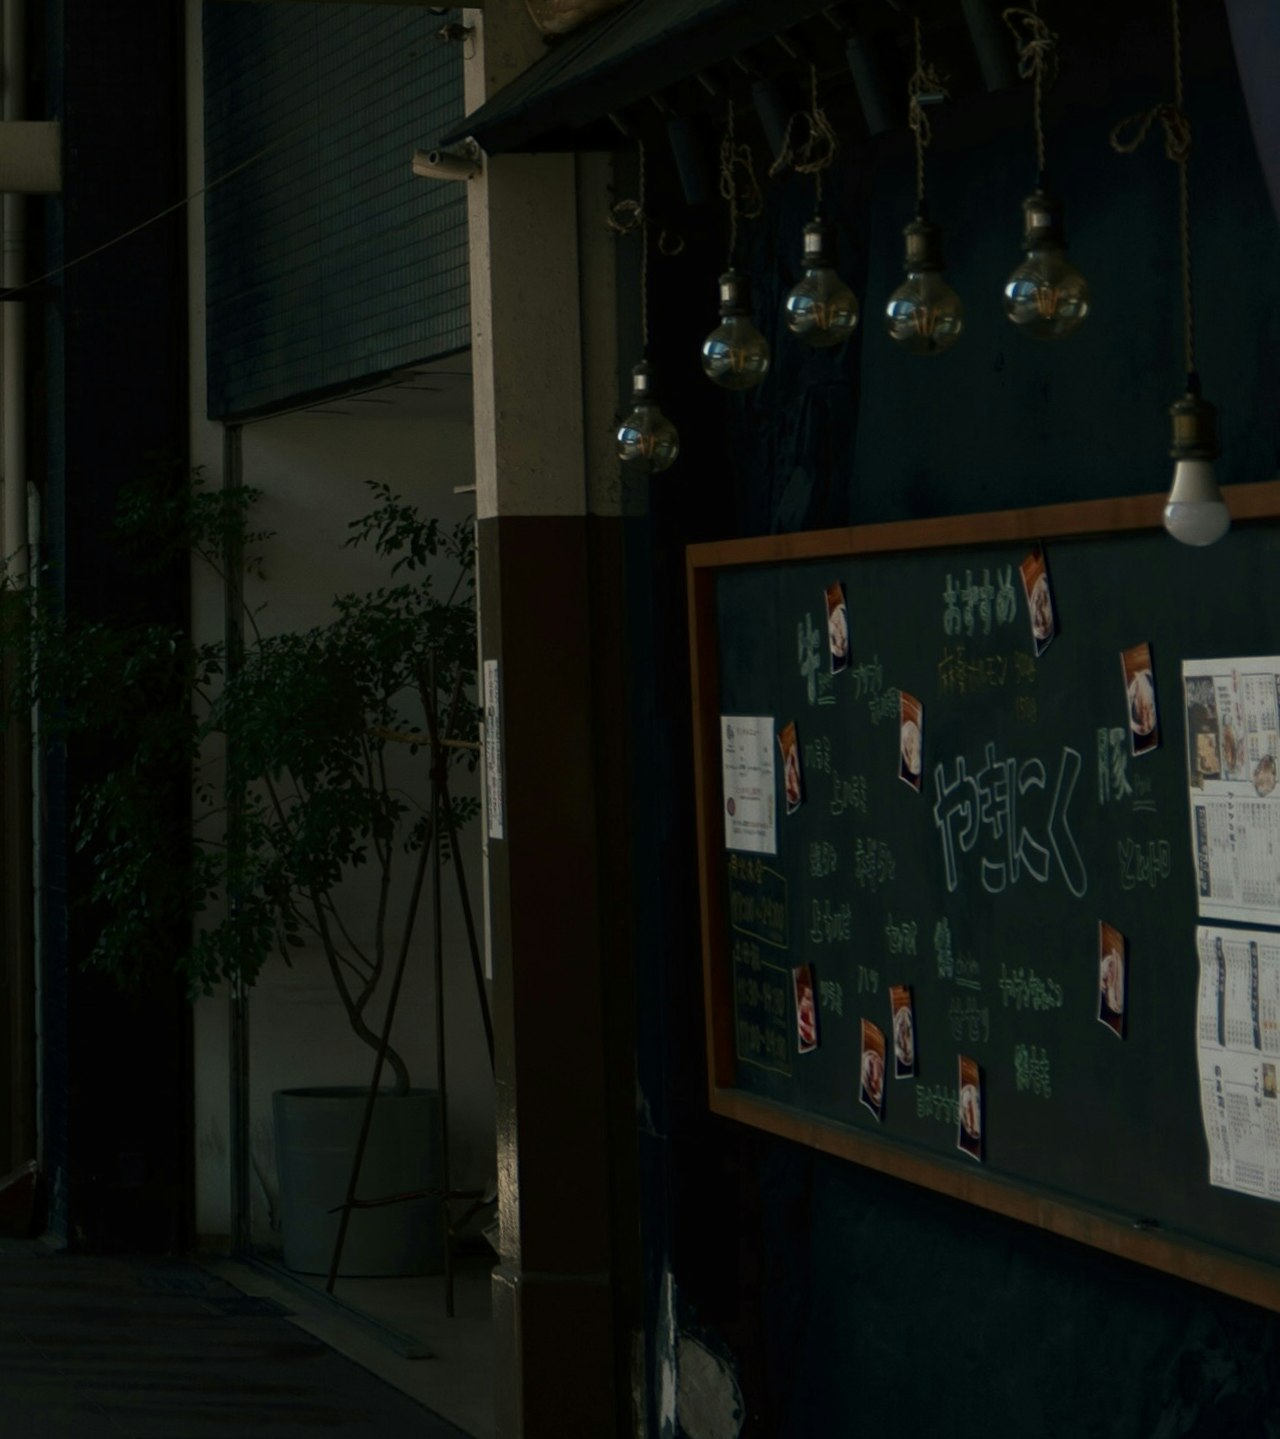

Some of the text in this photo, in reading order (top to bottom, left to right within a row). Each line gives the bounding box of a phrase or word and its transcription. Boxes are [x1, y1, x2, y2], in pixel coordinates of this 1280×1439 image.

[942, 564, 1017, 637] おすすめ
[933, 741, 1090, 898] やきにく
